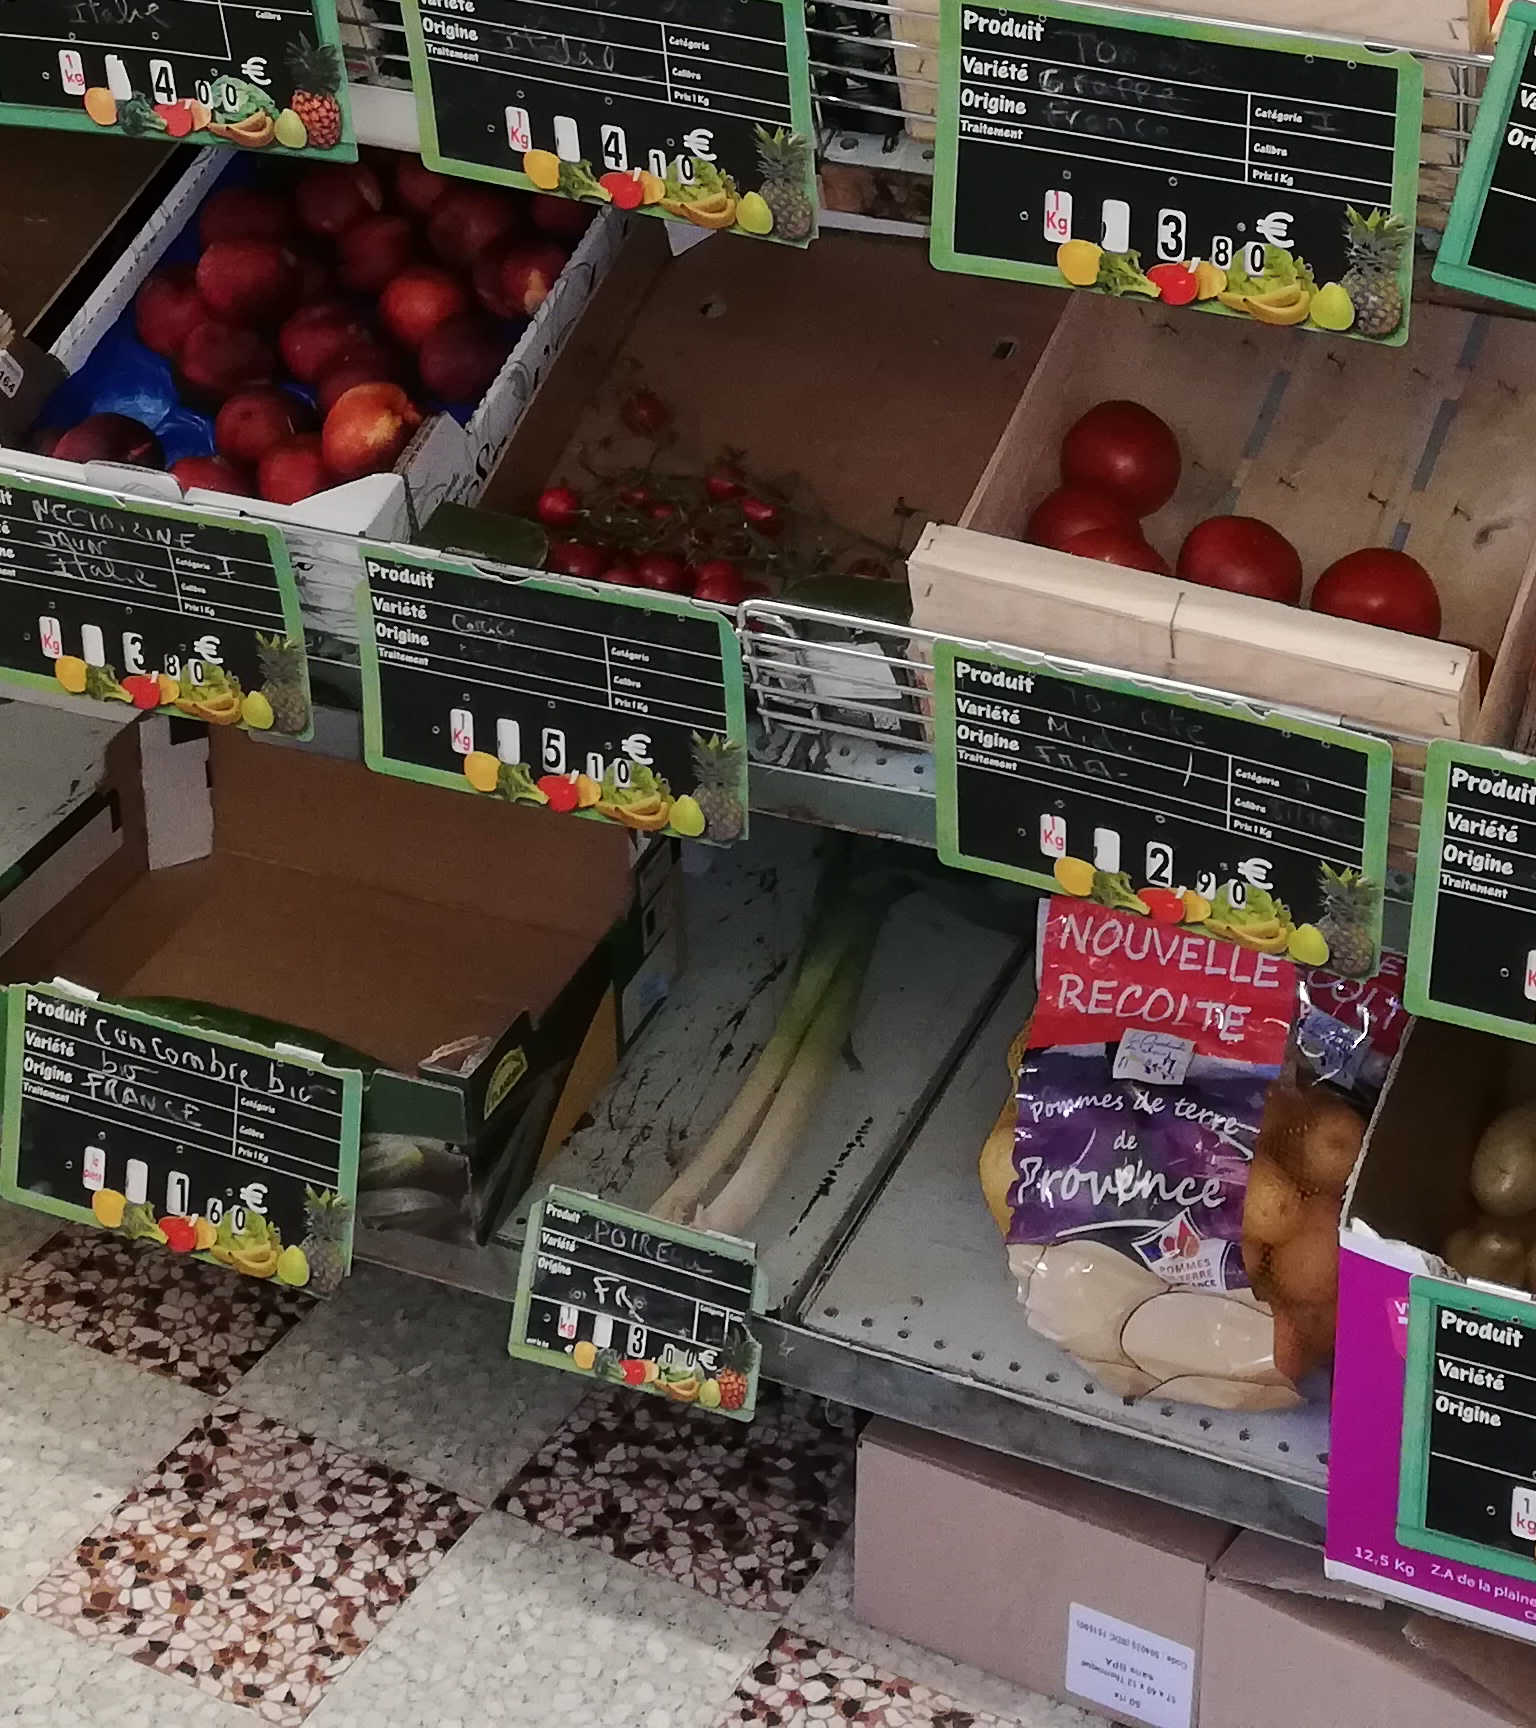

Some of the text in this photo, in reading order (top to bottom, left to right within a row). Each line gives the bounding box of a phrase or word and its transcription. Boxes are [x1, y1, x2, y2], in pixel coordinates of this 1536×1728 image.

[421, 17, 479, 43] Origine
[962, 9, 1046, 44] Produit
[960, 87, 1028, 117] Origine
[962, 55, 1304, 124] Variété Catégorie
[959, 119, 1024, 141] Traitement
[367, 561, 435, 590] Produit
[372, 596, 429, 621] Variété
[375, 622, 430, 647] Origine
[956, 661, 1035, 694] Produit
[956, 697, 1022, 725] Variété
[956, 724, 1021, 752] Origine
[1446, 811, 1520, 844] Variété
[1442, 845, 1514, 877] Origine
[1440, 875, 1510, 901] Traitement
[1059, 913, 1283, 989] NOUVELLE
[26, 995, 88, 1027] Produit
[24, 1029, 76, 1058] Variété
[80, 1072, 202, 1126] FRANCE
[1112, 1129, 1138, 1152] de
[1438, 1309, 1525, 1349] Produit
[1436, 1358, 1507, 1393] Variété
[1434, 1395, 1503, 1429] Origine
[1353, 1545, 1391, 1570] 12,5
[1393, 1557, 1417, 1579] Kg
[1456, 1571, 1473, 1587] de
[1475, 1576, 1491, 1594] la
